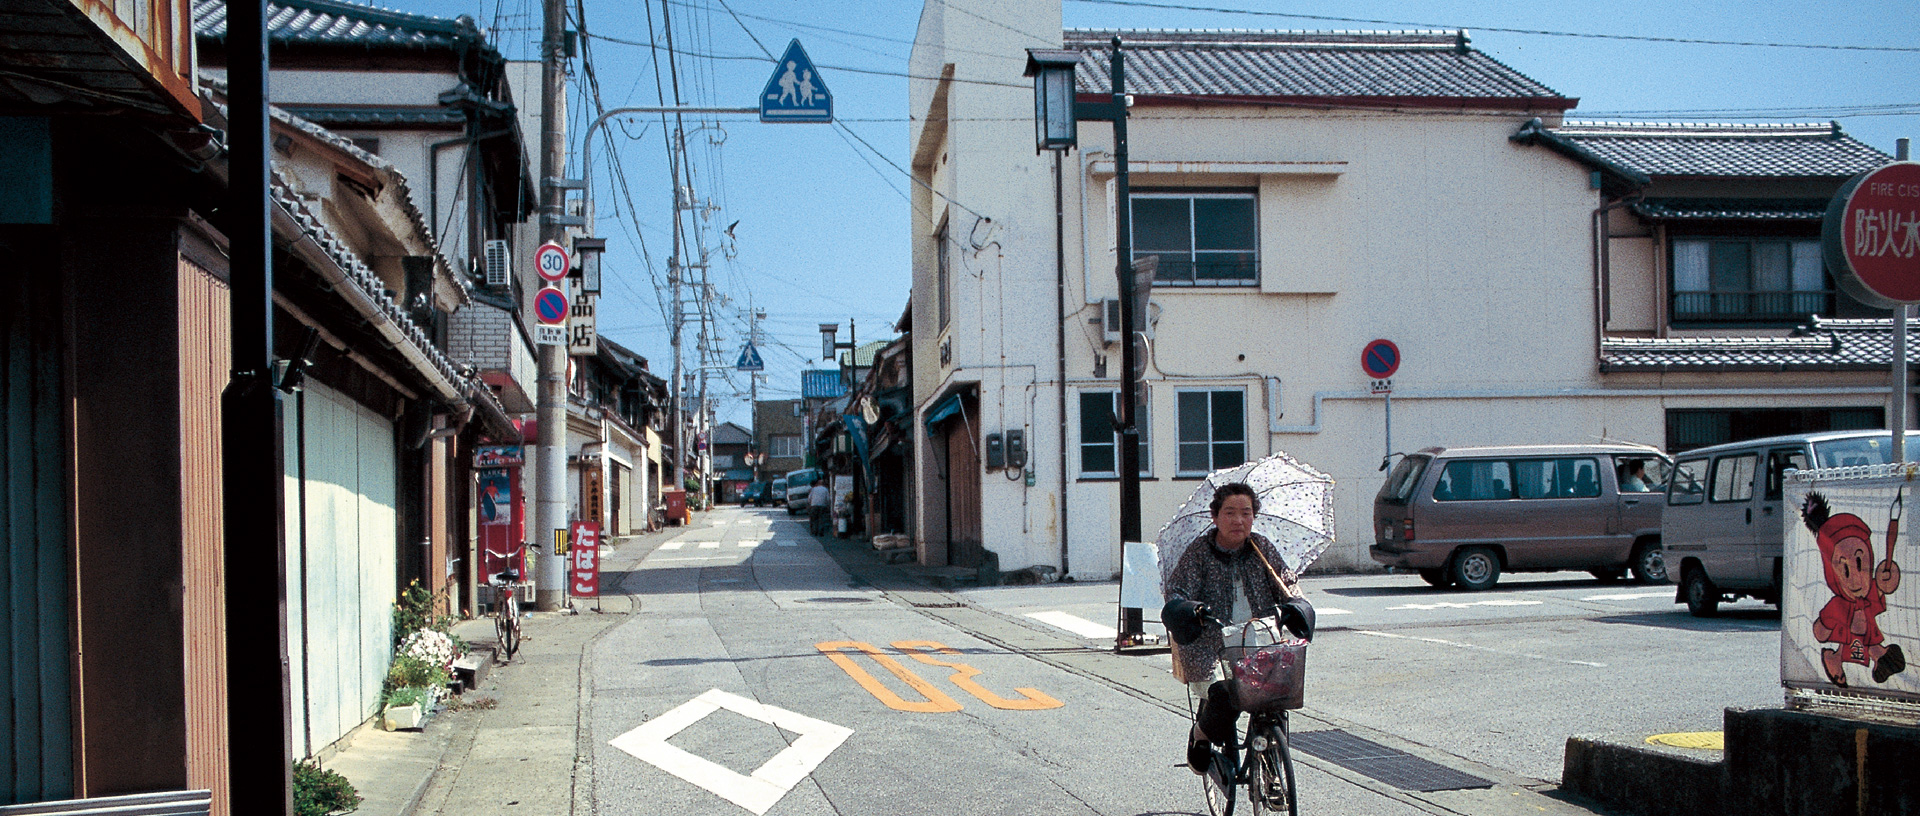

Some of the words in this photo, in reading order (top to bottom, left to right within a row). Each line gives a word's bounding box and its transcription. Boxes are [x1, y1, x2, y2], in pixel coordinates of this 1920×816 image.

[1870, 182, 1894, 197] FIRE
[1854, 208, 1920, 259] 防火水
[542, 253, 563, 271] 30
[575, 524, 595, 593] たばこ
[1850, 638, 1866, 661] 金
[813, 640, 1066, 714] 30
